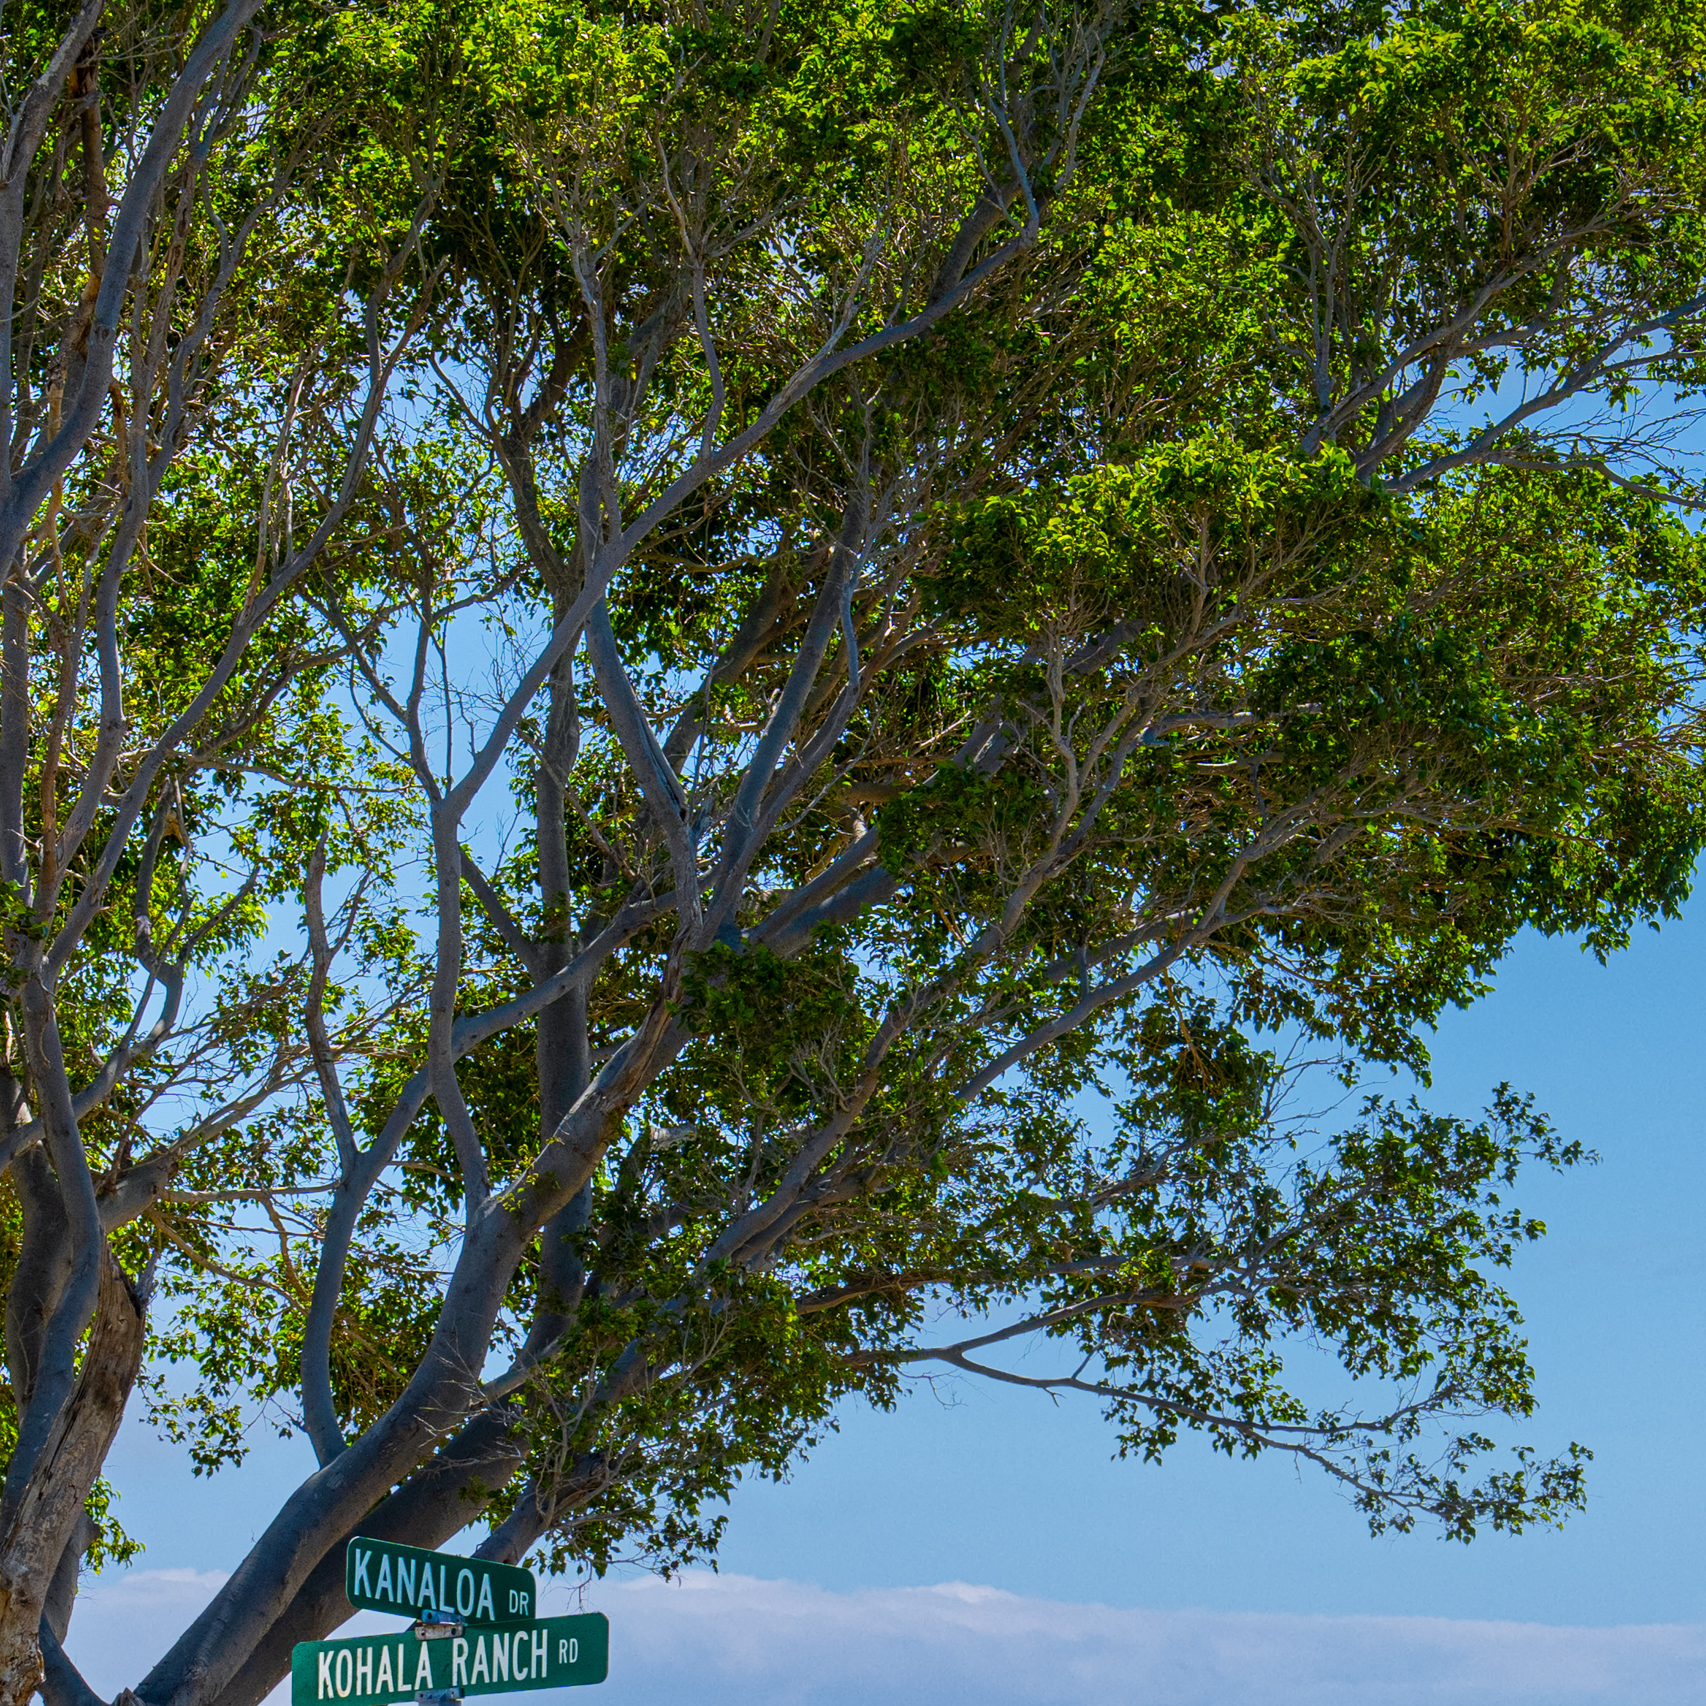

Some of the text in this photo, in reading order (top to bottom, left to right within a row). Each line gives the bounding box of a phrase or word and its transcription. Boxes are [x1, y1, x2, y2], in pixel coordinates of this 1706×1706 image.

[354, 1548, 529, 1621] KANALOA DR
[318, 1629, 579, 1700] KOHALA RANCH RD
